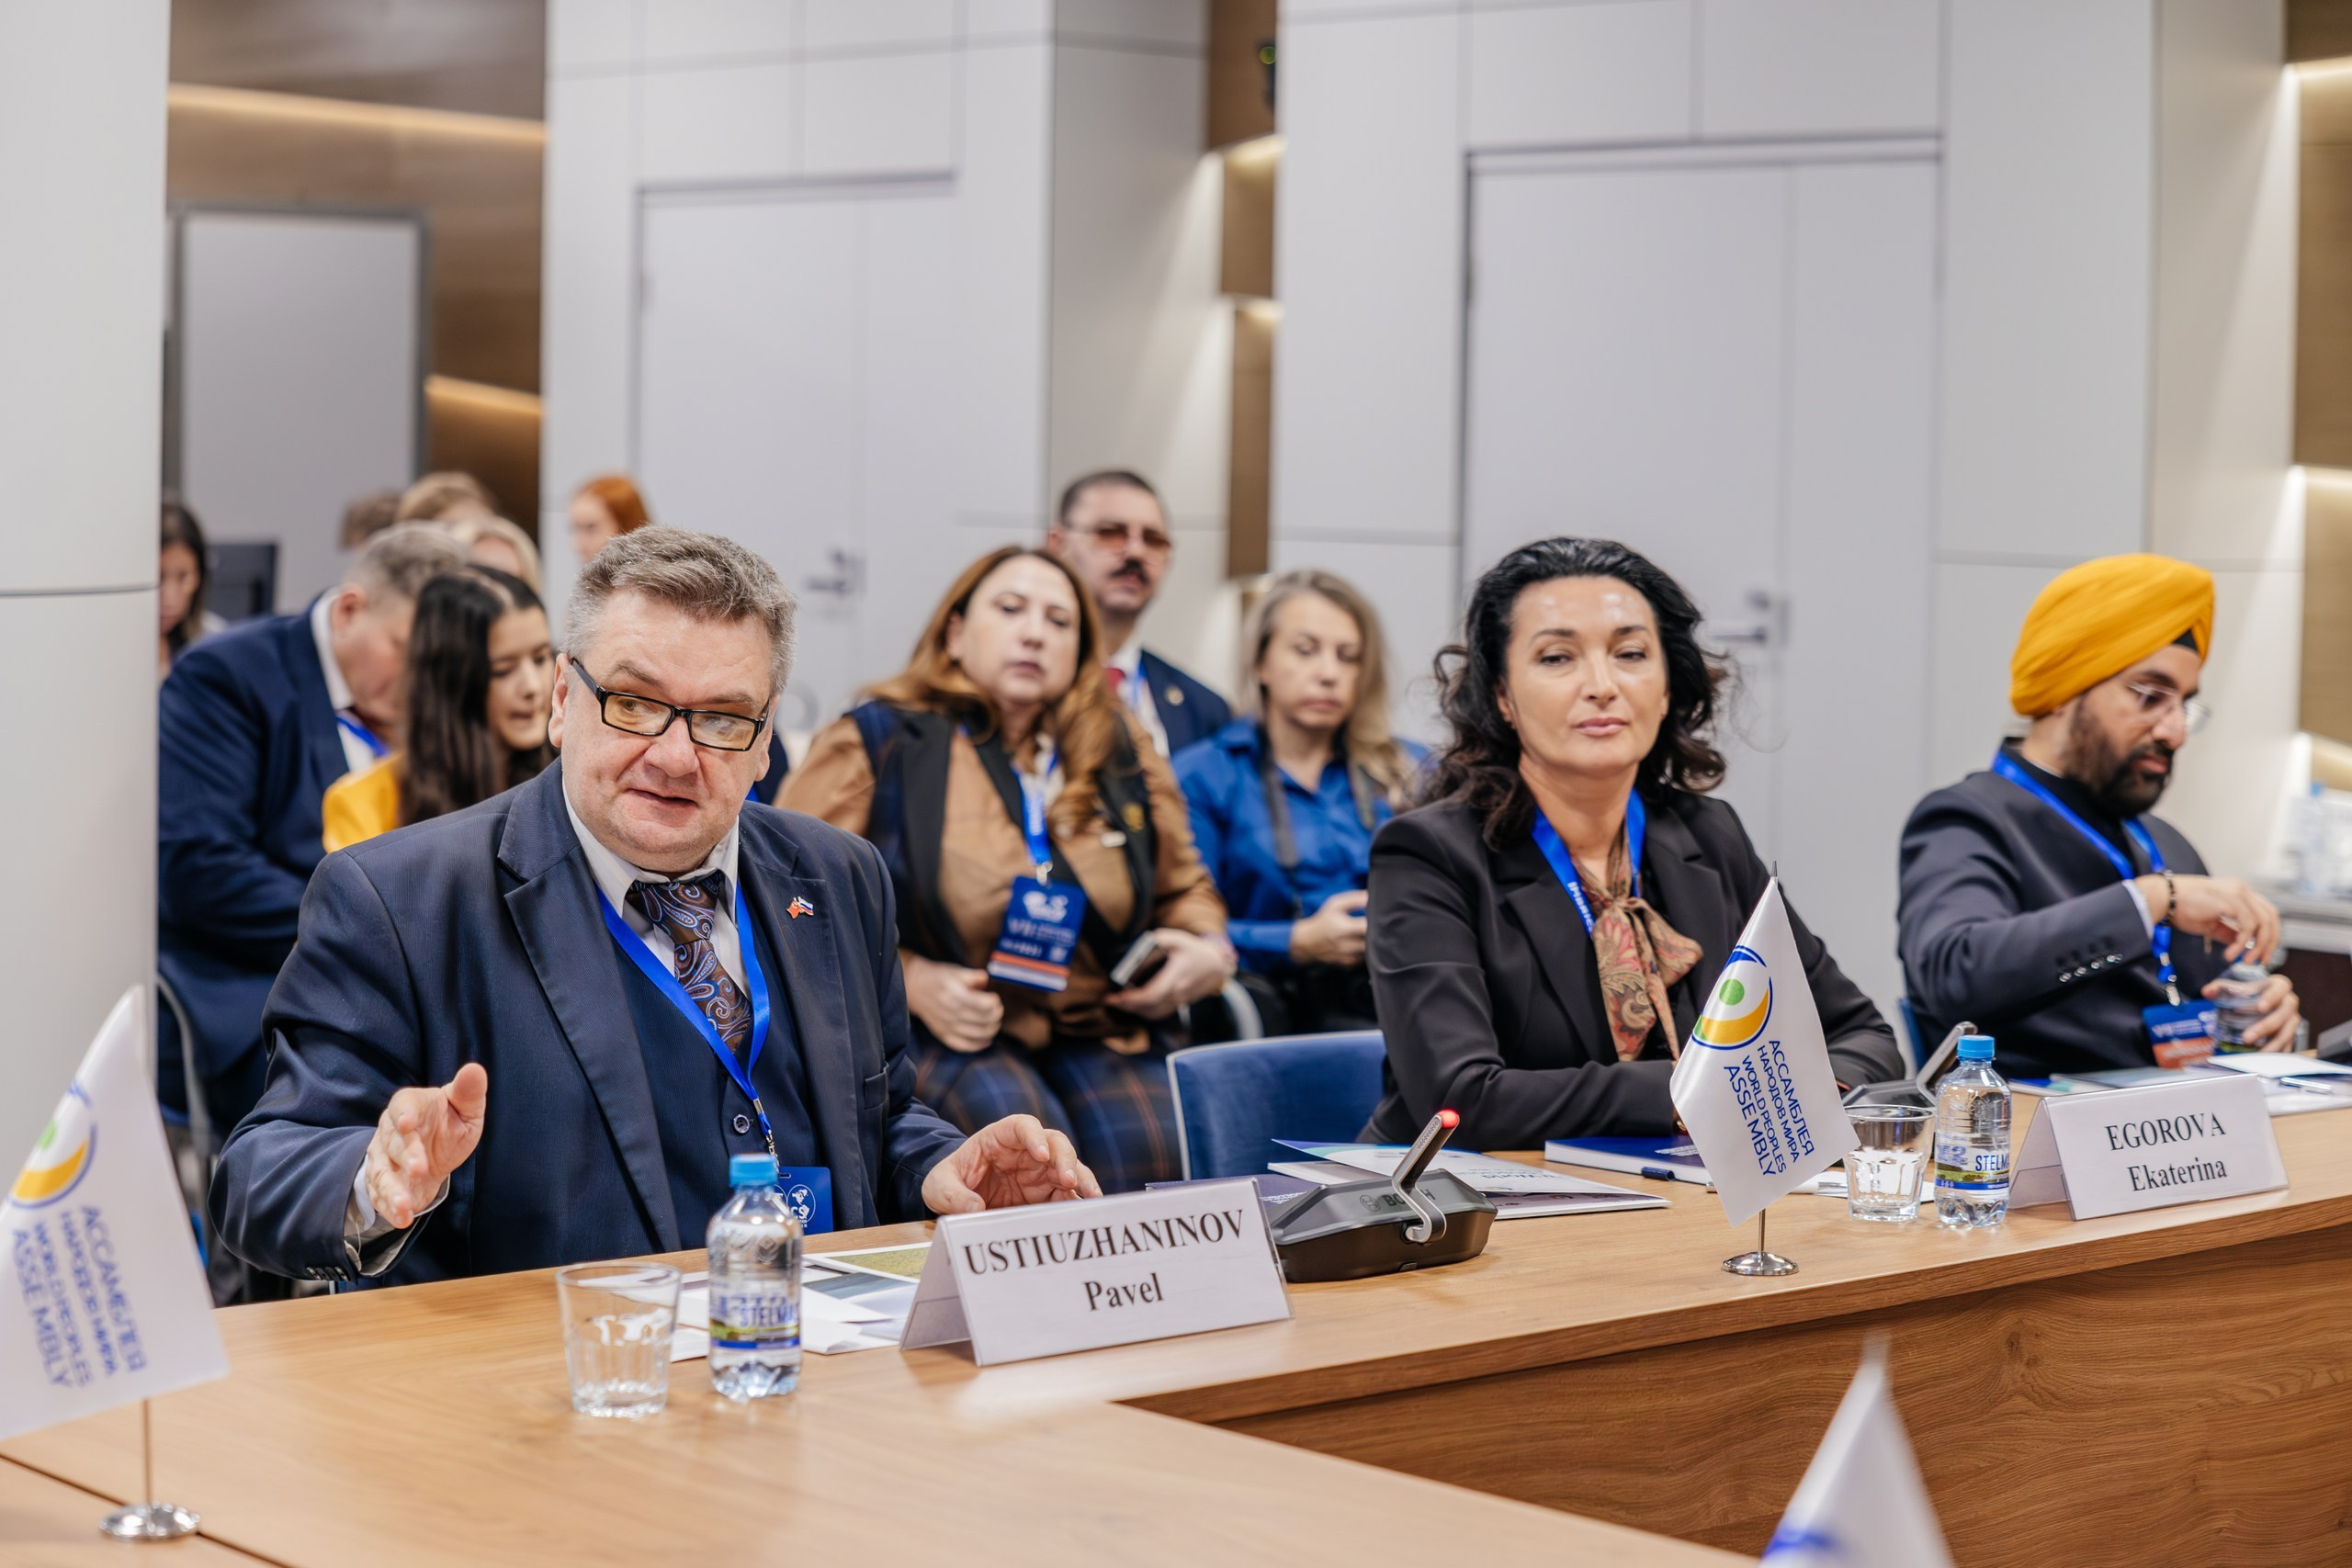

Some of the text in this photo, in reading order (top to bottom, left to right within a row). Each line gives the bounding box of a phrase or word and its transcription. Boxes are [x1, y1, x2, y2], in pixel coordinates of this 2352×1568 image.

[1742, 1055, 1786, 1173] WORLD PEOPLES
[1758, 1044, 1800, 1163] НАРОДОВ МИРА
[1769, 1041, 1815, 1156] АССАМБЛЕЯ
[2105, 1111, 2226, 1151] EGOROVA
[1975, 1154, 2009, 1171] STELM
[2128, 1157, 2228, 1192] Ekaterina
[1382, 1189, 1436, 1206] BOH
[963, 1208, 1244, 1275] USTIUZHANINOV
[1083, 1273, 1164, 1312] Pavel
